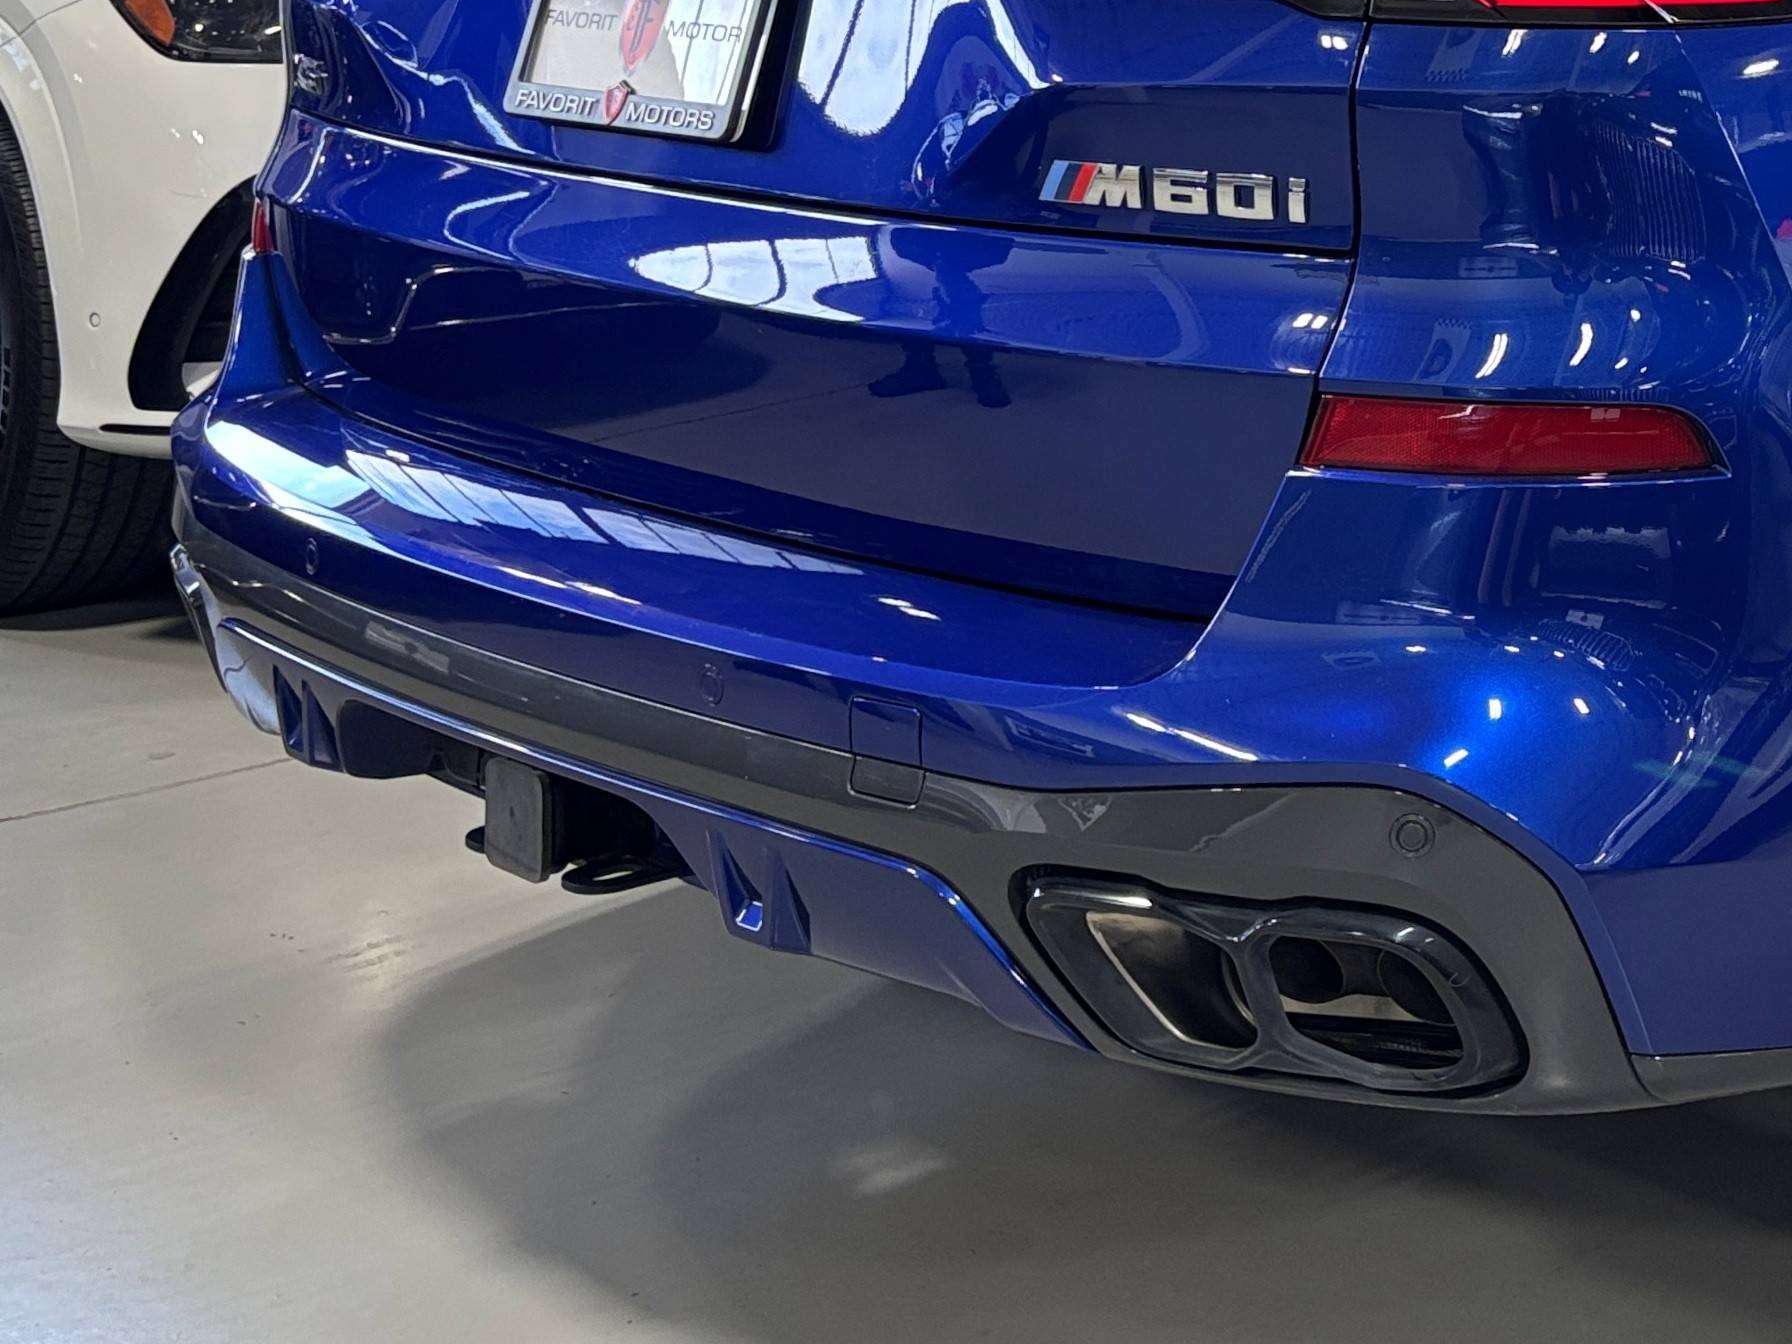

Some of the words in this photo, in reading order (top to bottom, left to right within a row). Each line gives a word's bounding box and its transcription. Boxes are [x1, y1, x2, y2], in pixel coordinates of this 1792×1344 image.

[546, 9, 618, 31] FAVORIT
[515, 89, 596, 116] FAVORIT
[625, 101, 715, 131] MOTORS
